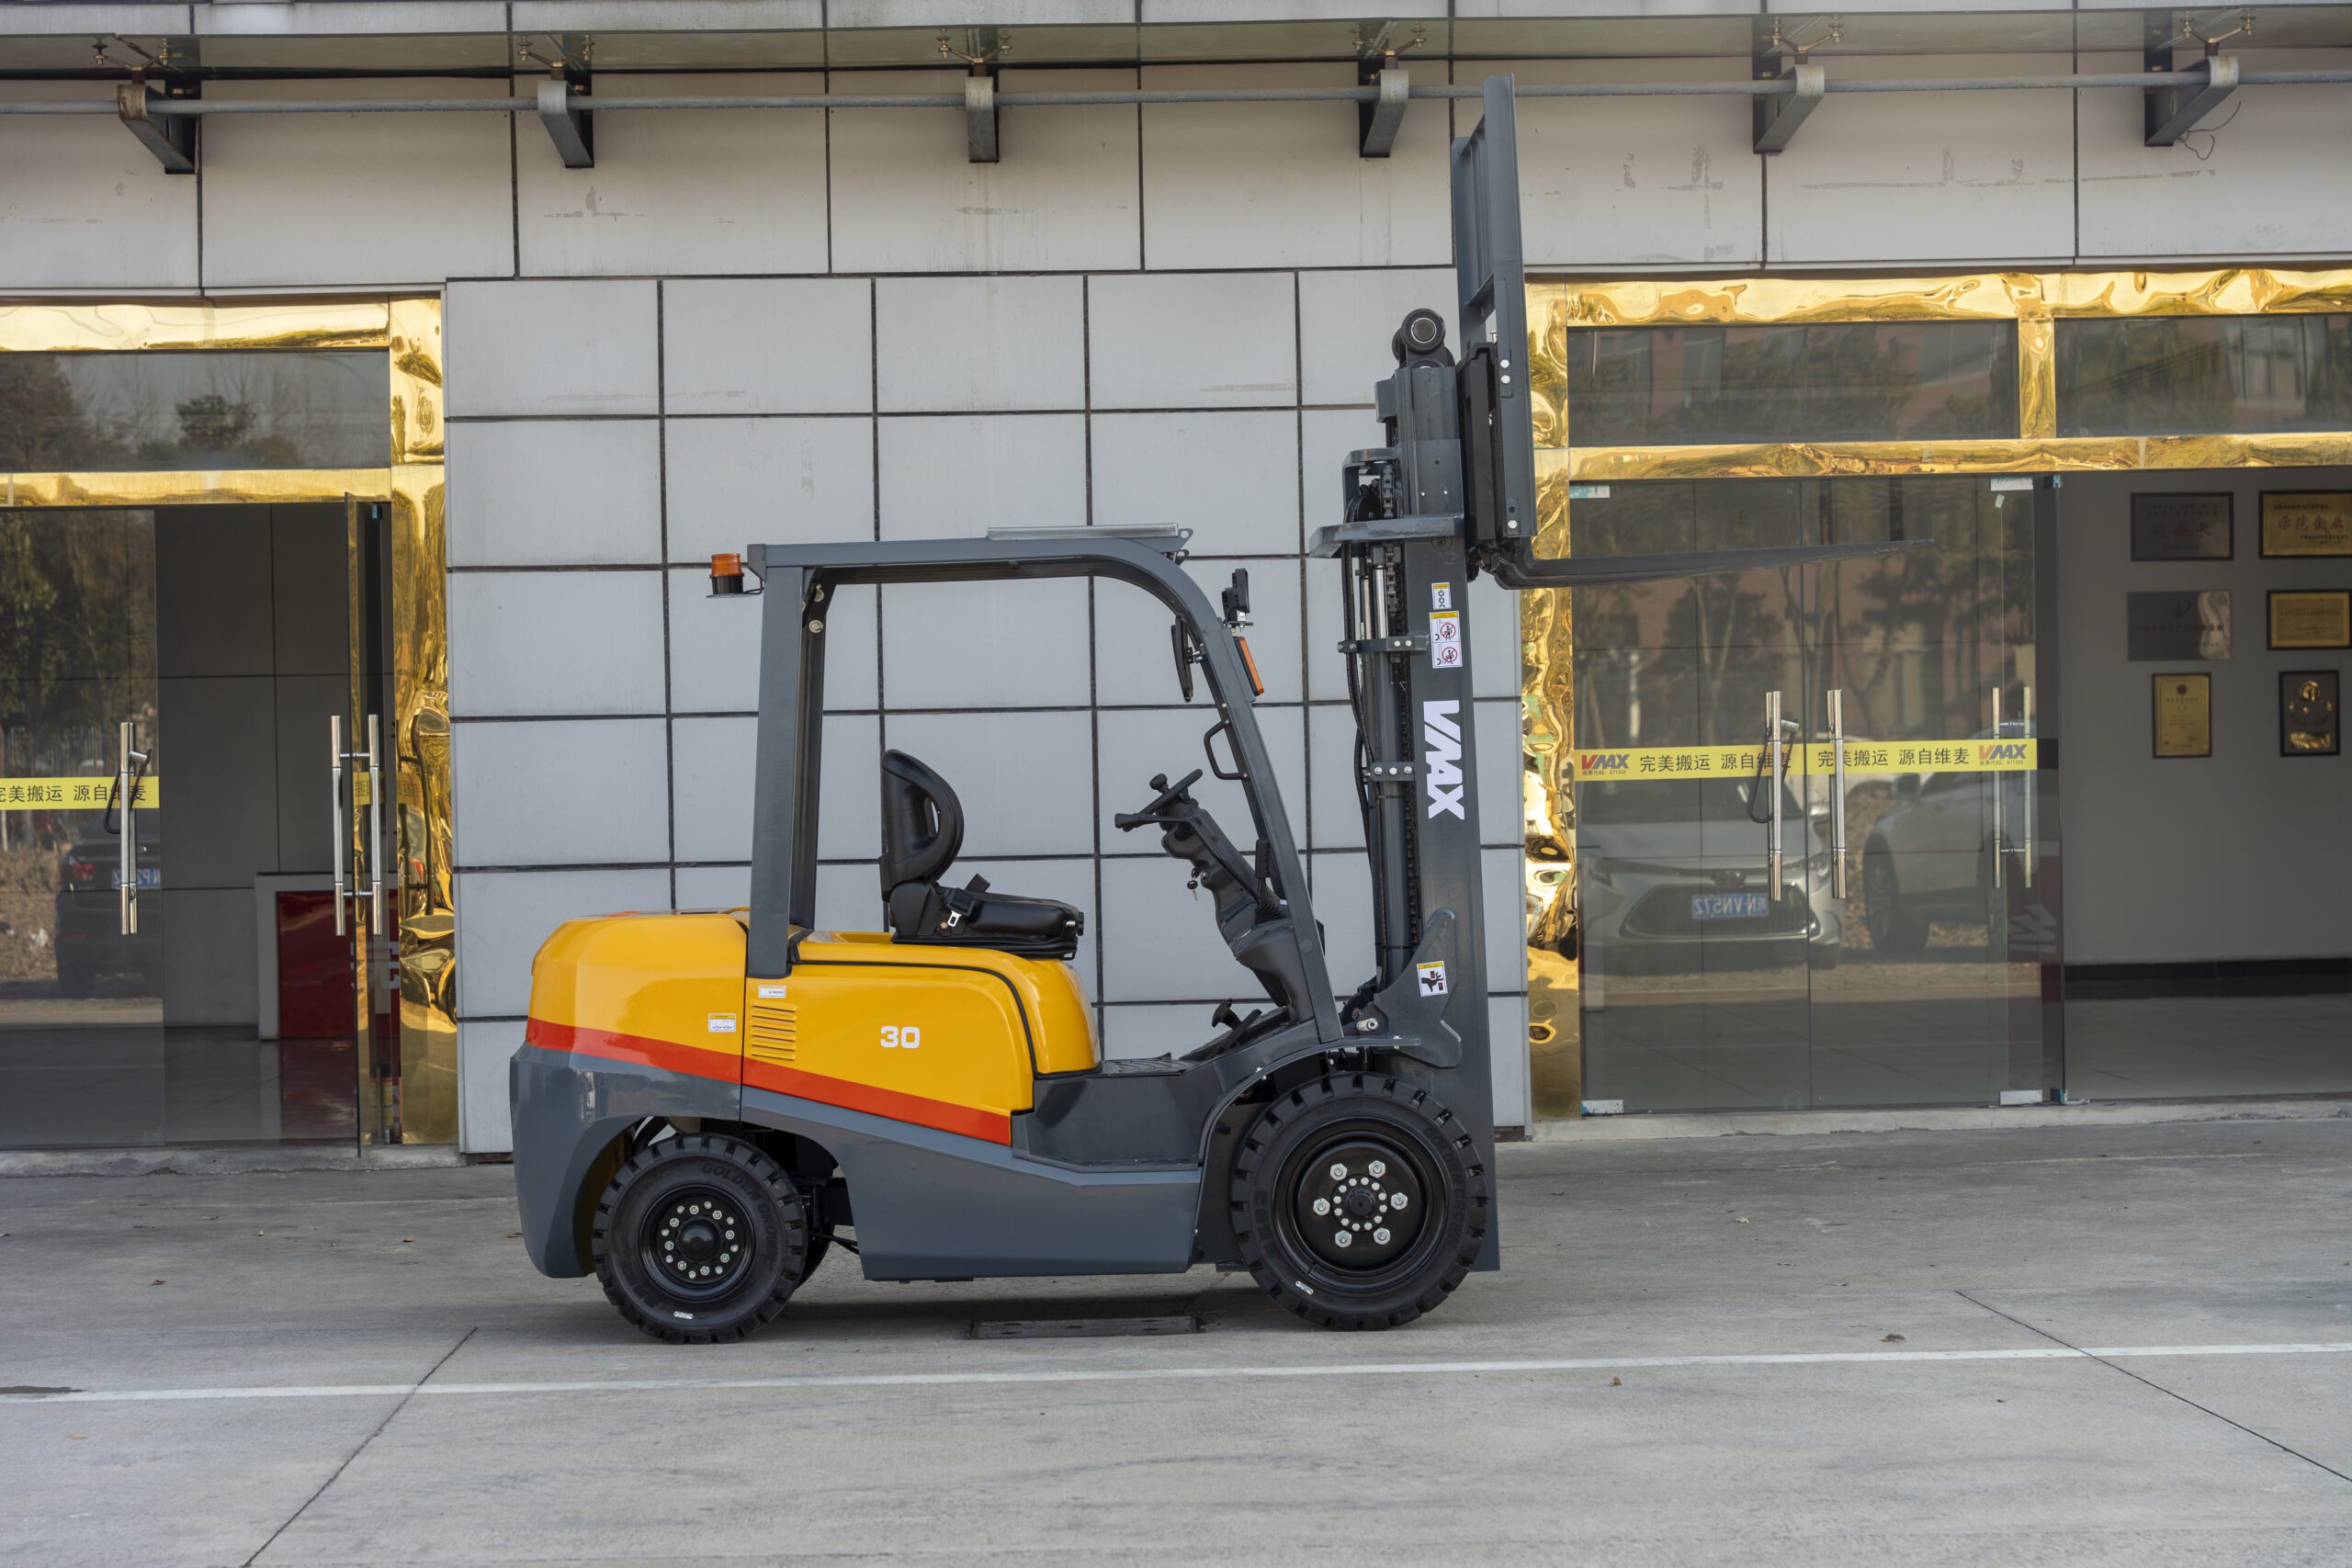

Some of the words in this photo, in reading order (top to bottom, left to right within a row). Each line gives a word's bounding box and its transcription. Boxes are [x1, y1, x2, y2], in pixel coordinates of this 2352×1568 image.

[1423, 699, 1465, 820] VMAX
[1898, 747, 1970, 765] 源自维麦
[1978, 743, 2028, 760] VMAX
[1581, 753, 1630, 771] VMAX
[1640, 754, 1711, 773] 完美搬运
[880, 1026, 921, 1049] 30
[701, 1162, 763, 1202] GOLDEN
